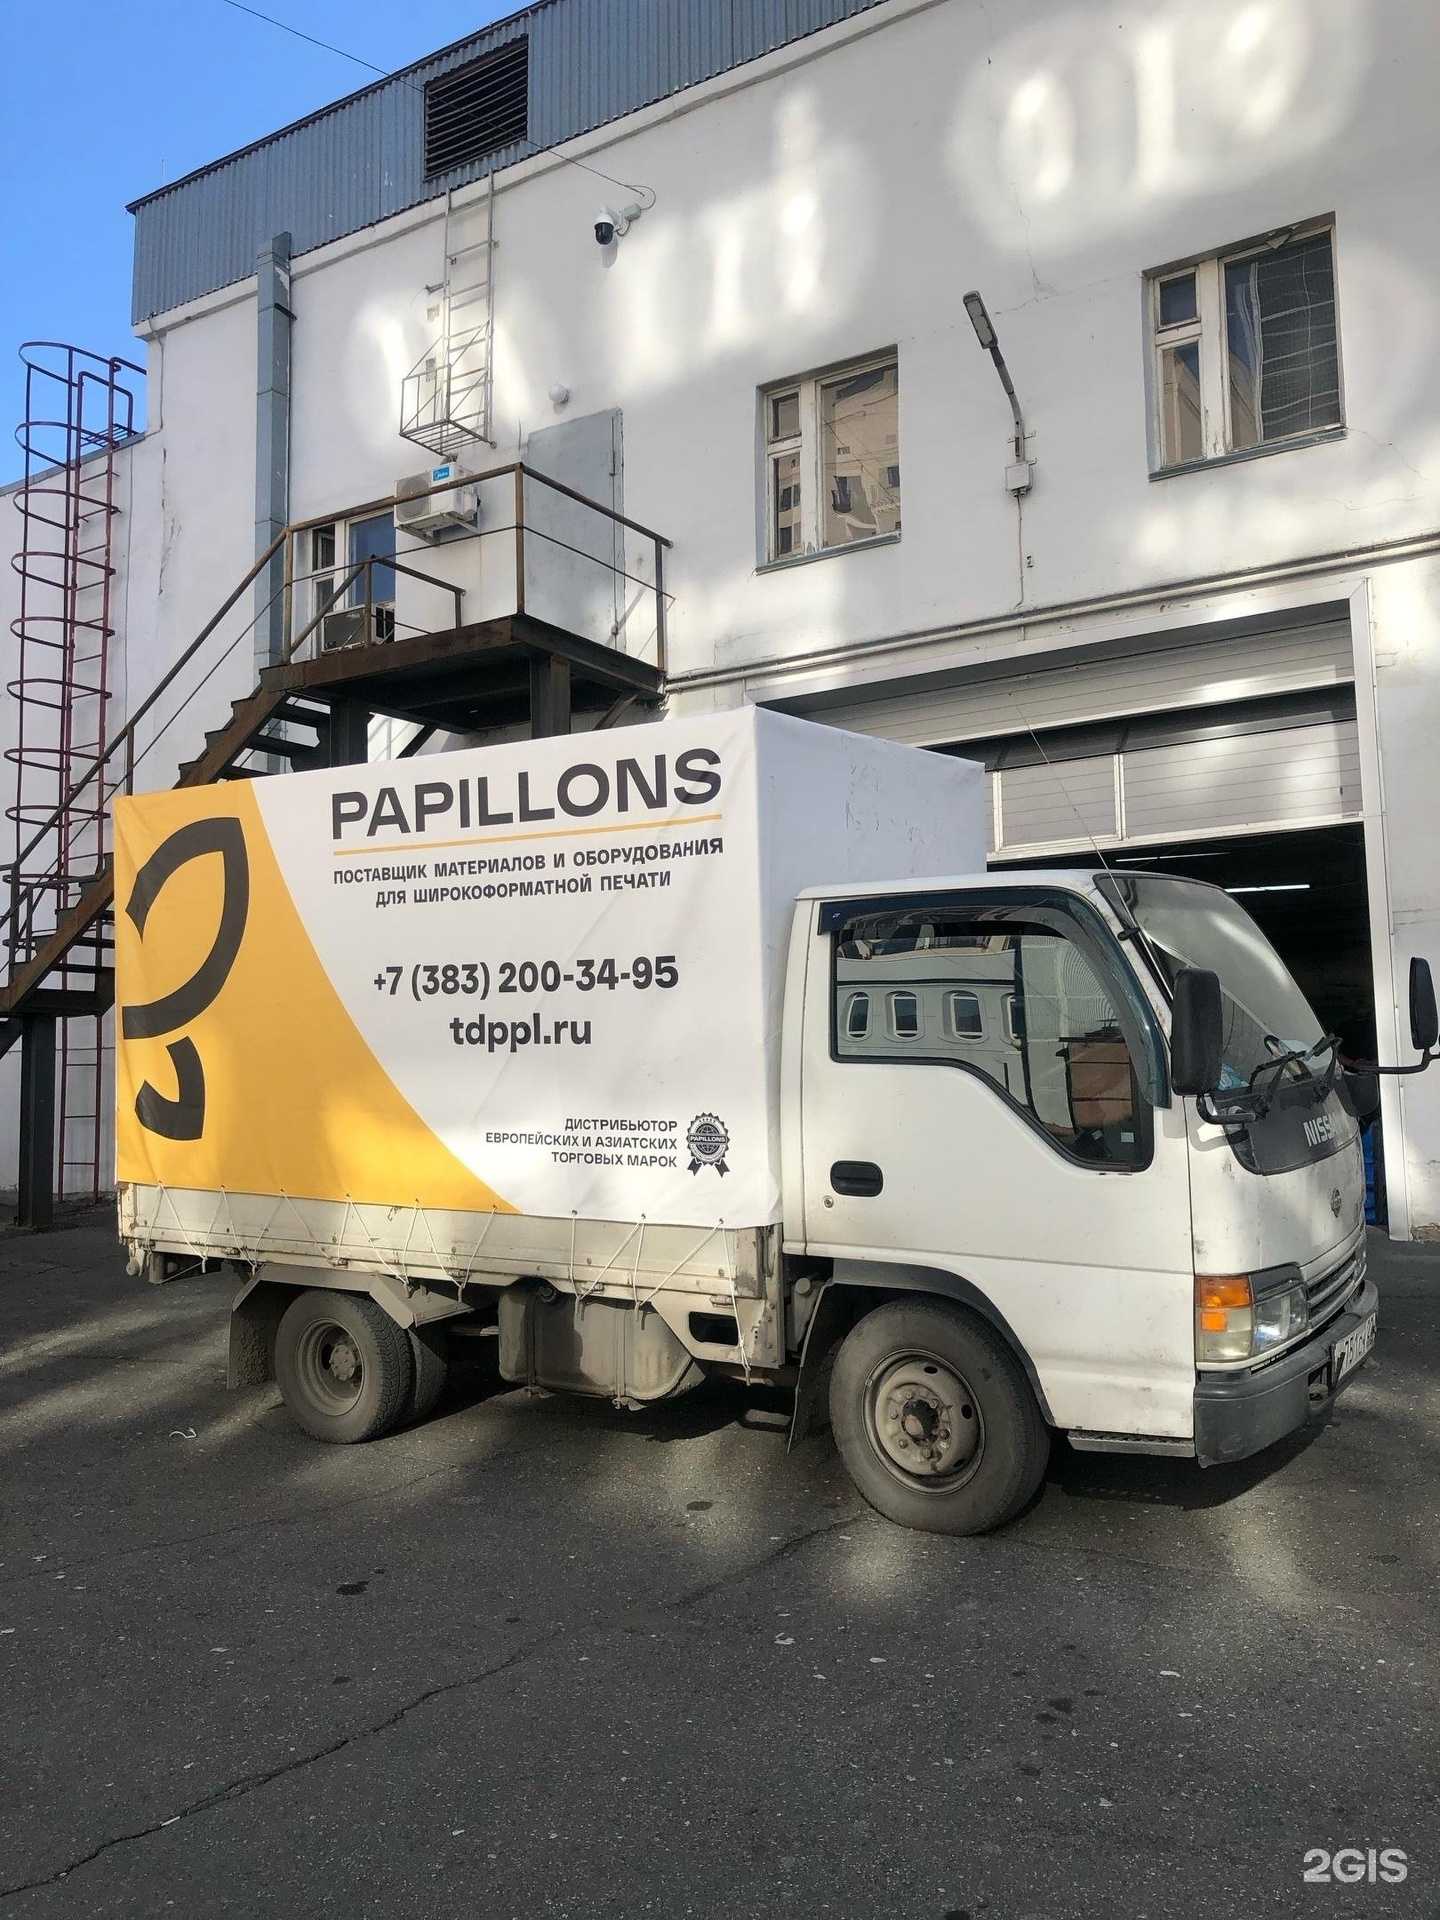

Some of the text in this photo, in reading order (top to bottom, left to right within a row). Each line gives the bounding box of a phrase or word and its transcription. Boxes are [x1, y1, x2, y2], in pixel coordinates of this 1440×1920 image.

[331, 747, 722, 840] PAPILLONS
[333, 837, 724, 885] ПОСТАВЩИК МАТЕРИАЛОВ И ОБОРУДОВАНИЯ
[375, 870, 671, 909] ДЛЯ ШИРОКОФОРМАТНОЙ ПЕЧАТИ
[373, 955, 679, 1002] +7 (383) 200-34-95
[449, 1012, 592, 1054] tdppl.ru
[486, 1132, 677, 1150] ЕВРОПЕЙСКИХ И АЗИАТСКИХ
[564, 1118, 678, 1132] ДИСТРИБЬЮТОР
[1303, 1113, 1342, 1147] NISS
[551, 1151, 677, 1168] ТОРГОВЫХ МАРОК
